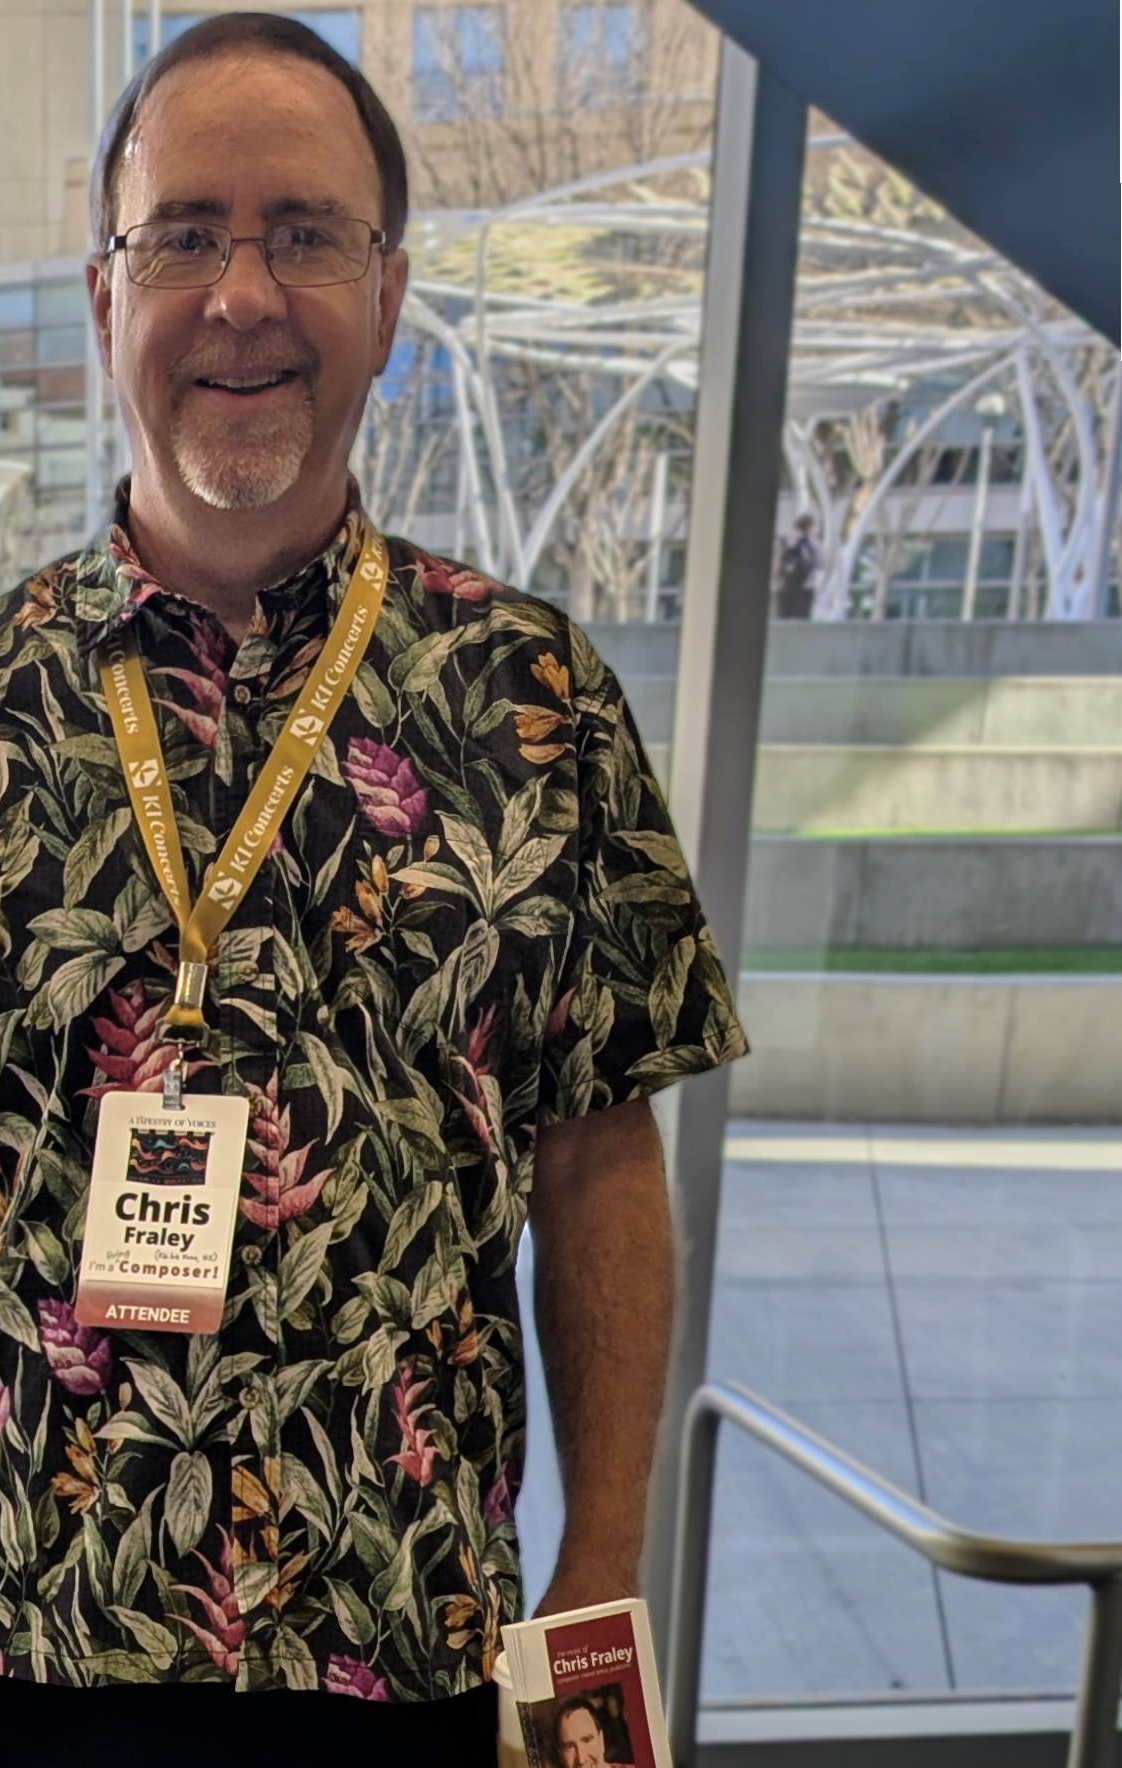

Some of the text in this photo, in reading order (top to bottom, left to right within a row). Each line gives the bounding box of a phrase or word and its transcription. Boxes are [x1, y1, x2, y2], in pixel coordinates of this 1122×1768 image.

[310, 604, 369, 711] KI Concerts
[143, 795, 162, 817] KI
[230, 765, 295, 874] KI Concerts
[115, 1192, 210, 1225] Chris
[124, 1227, 195, 1252] Fraley
[89, 1260, 219, 1279] I'm a Composer!
[105, 1305, 191, 1324] ATTENDEE
[554, 1655, 588, 1675] Chris
[590, 1646, 633, 1667] Fraley
